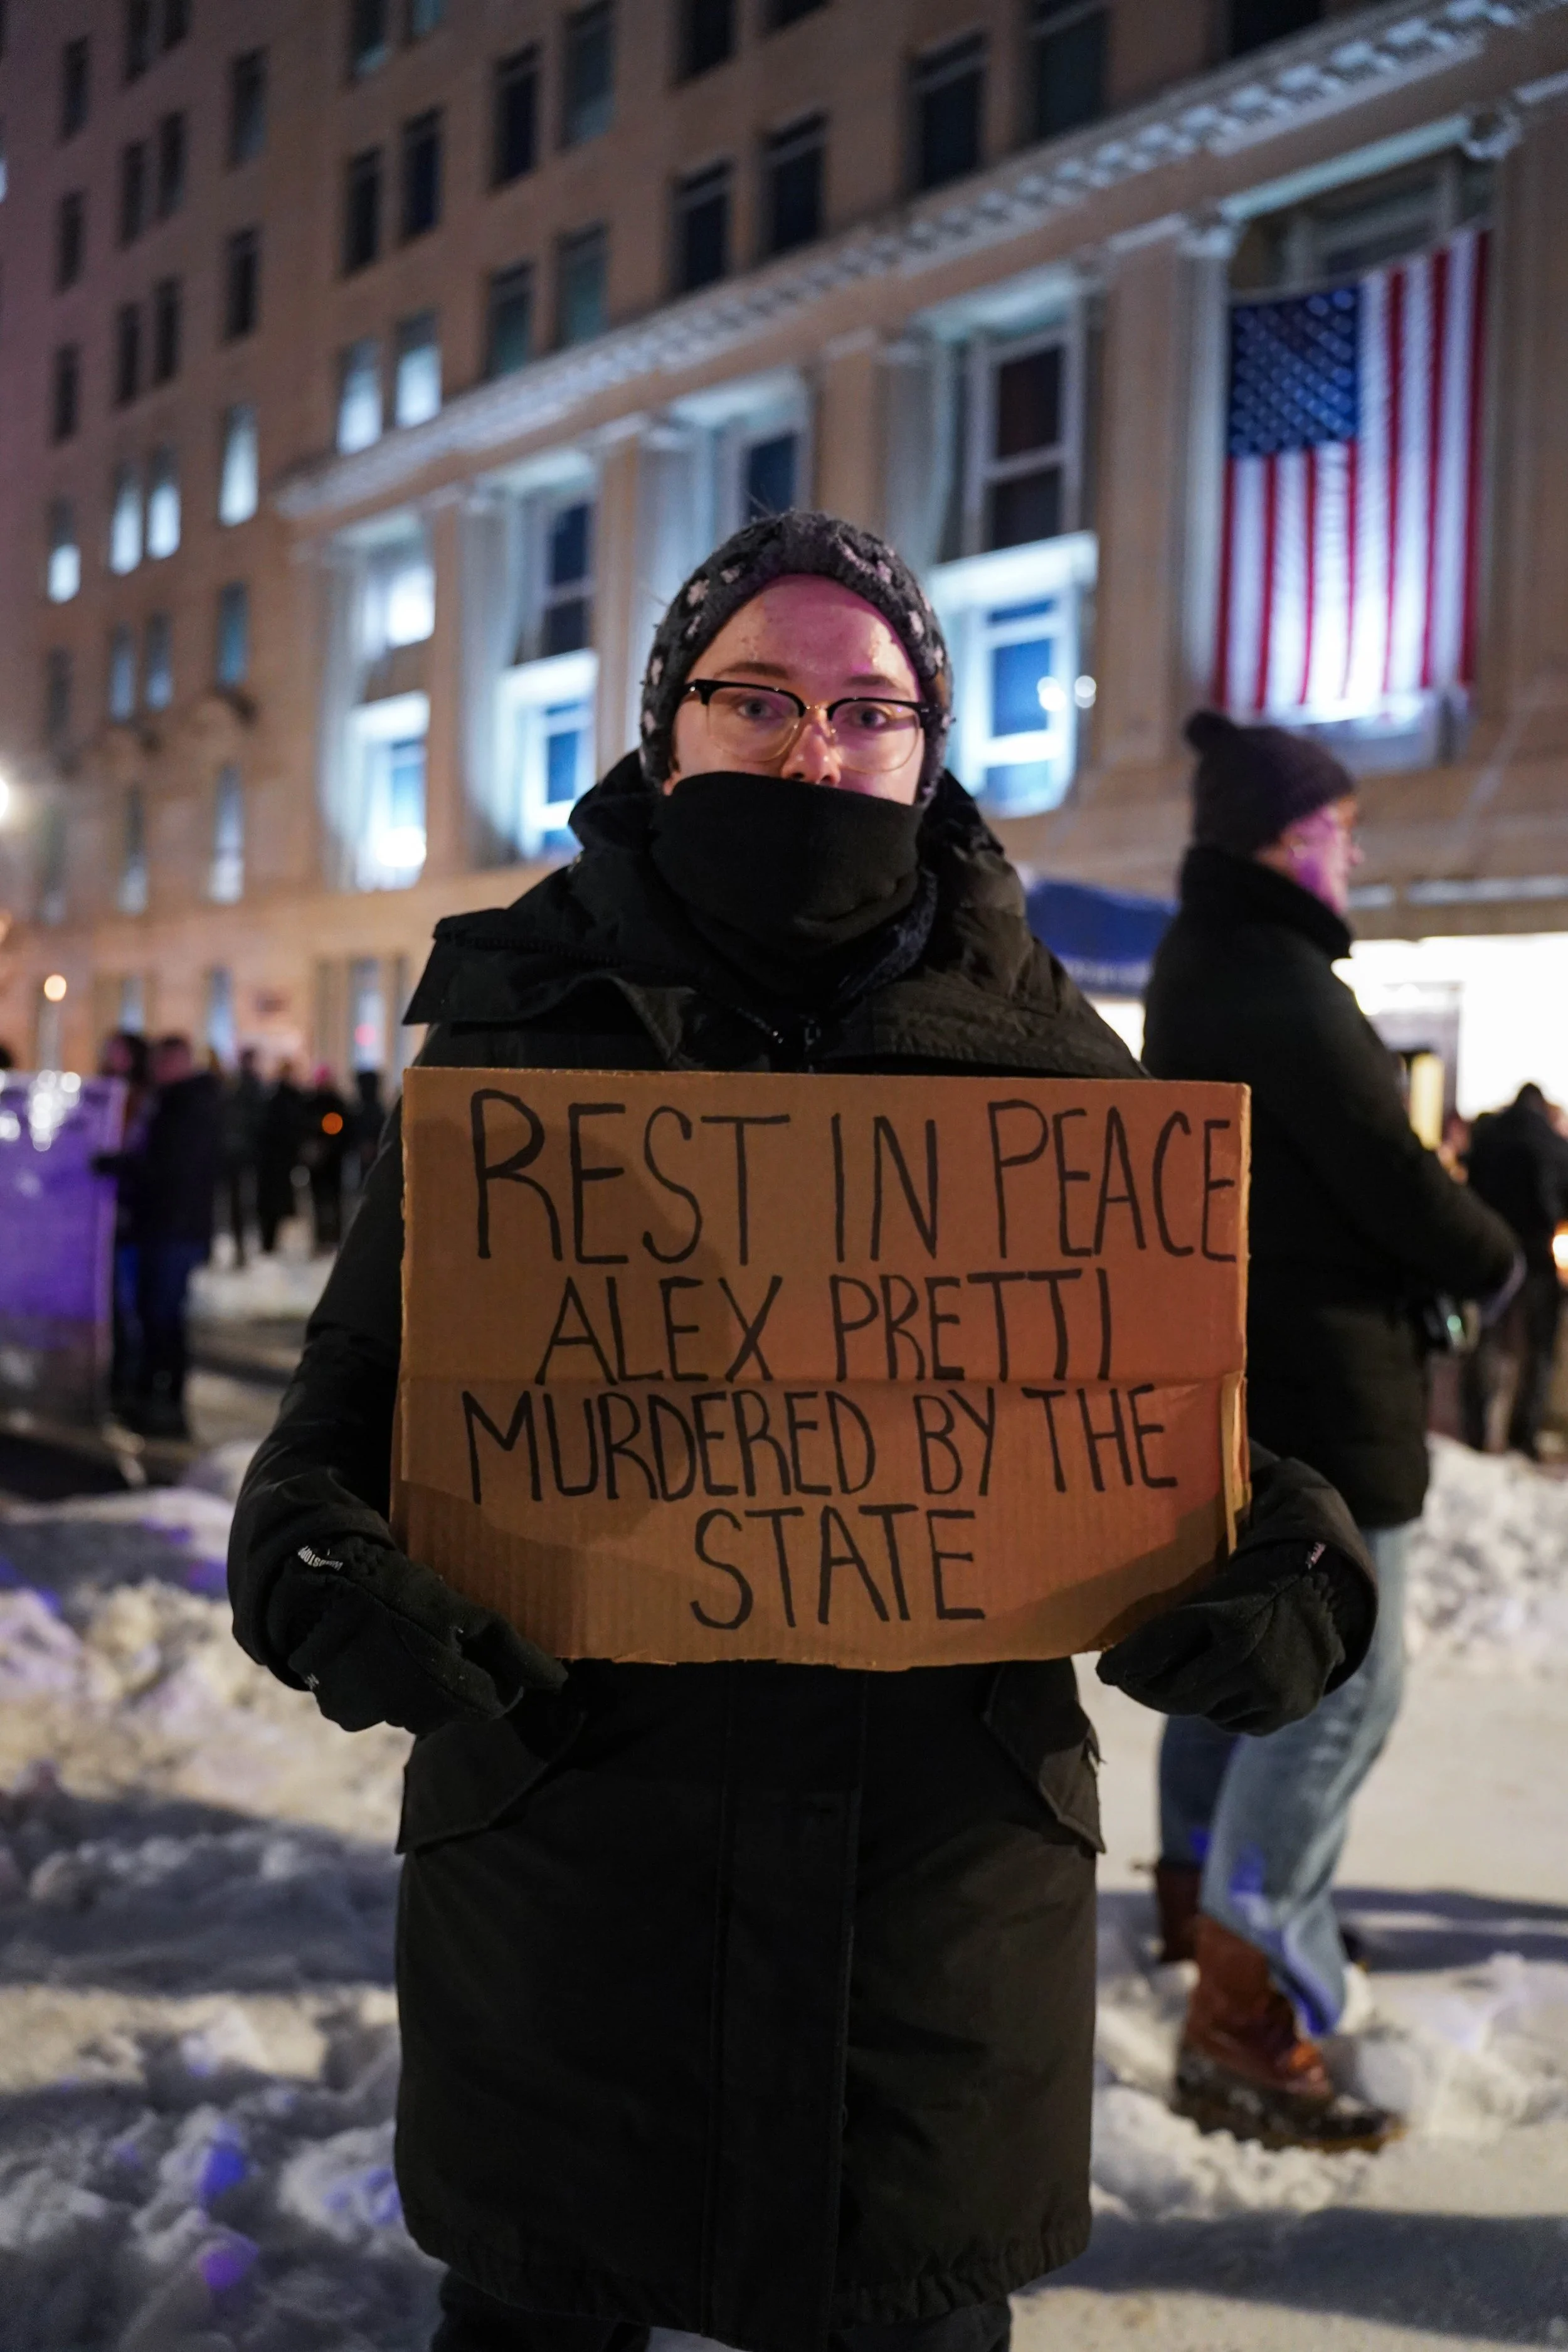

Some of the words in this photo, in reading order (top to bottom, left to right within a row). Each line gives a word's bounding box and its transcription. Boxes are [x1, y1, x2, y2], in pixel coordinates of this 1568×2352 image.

[470, 1089, 791, 1265] REST
[832, 1115, 938, 1262] IN
[988, 1100, 1237, 1262] PEACE
[535, 1276, 783, 1384] ALEX
[829, 1268, 1111, 1382] PRETTI
[462, 1388, 876, 1503] MURDERED
[913, 1392, 996, 1496] BY
[1022, 1384, 1178, 1493] THE
[691, 1504, 985, 1628] STATE
